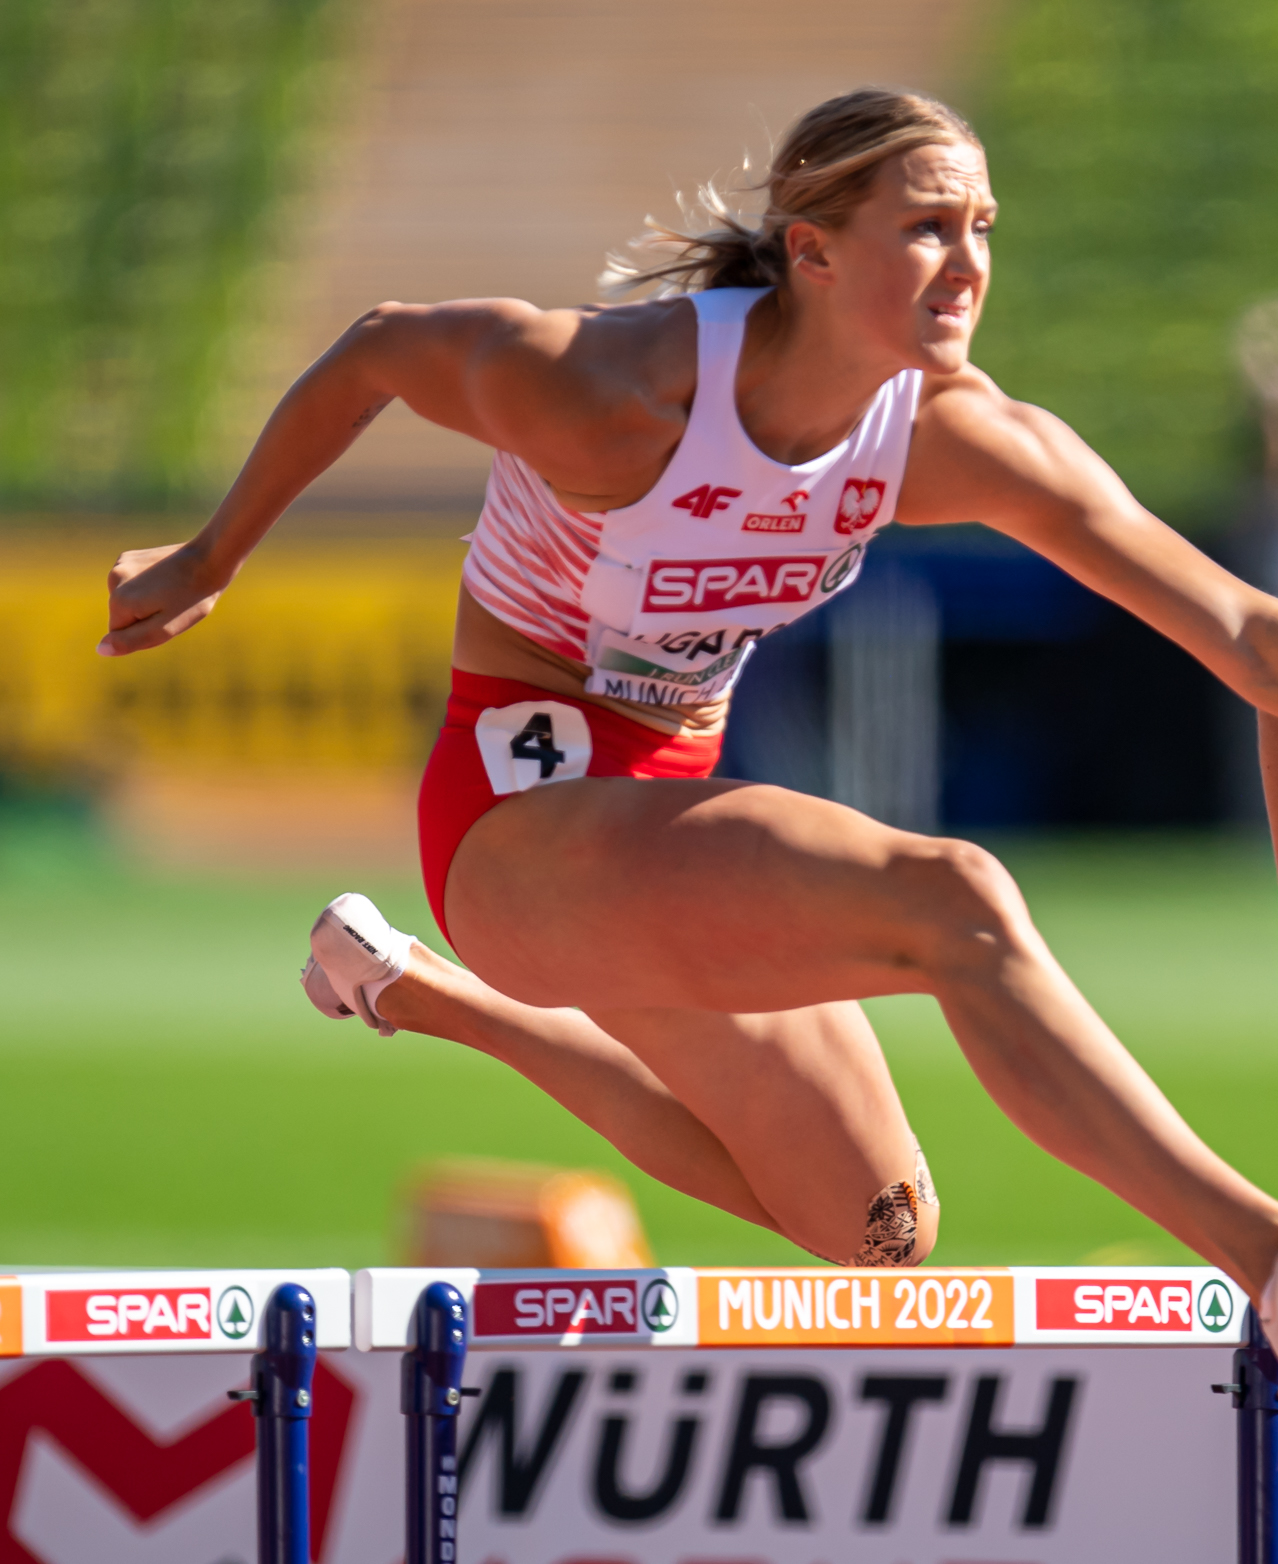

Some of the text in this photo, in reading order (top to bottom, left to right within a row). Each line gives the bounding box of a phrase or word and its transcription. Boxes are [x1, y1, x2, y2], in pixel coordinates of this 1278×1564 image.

[746, 516, 802, 532] ORLEN
[648, 562, 819, 607] SPAR
[707, 652, 737, 679] CLE
[605, 679, 716, 705] MUNICH
[510, 712, 565, 779] 4
[86, 1293, 211, 1336] SPAR
[514, 1288, 637, 1328] SPAR
[717, 1278, 994, 1330] MUNICH 2022
[1073, 1285, 1192, 1325] SPAR
[438, 1474, 457, 1564] MOND
